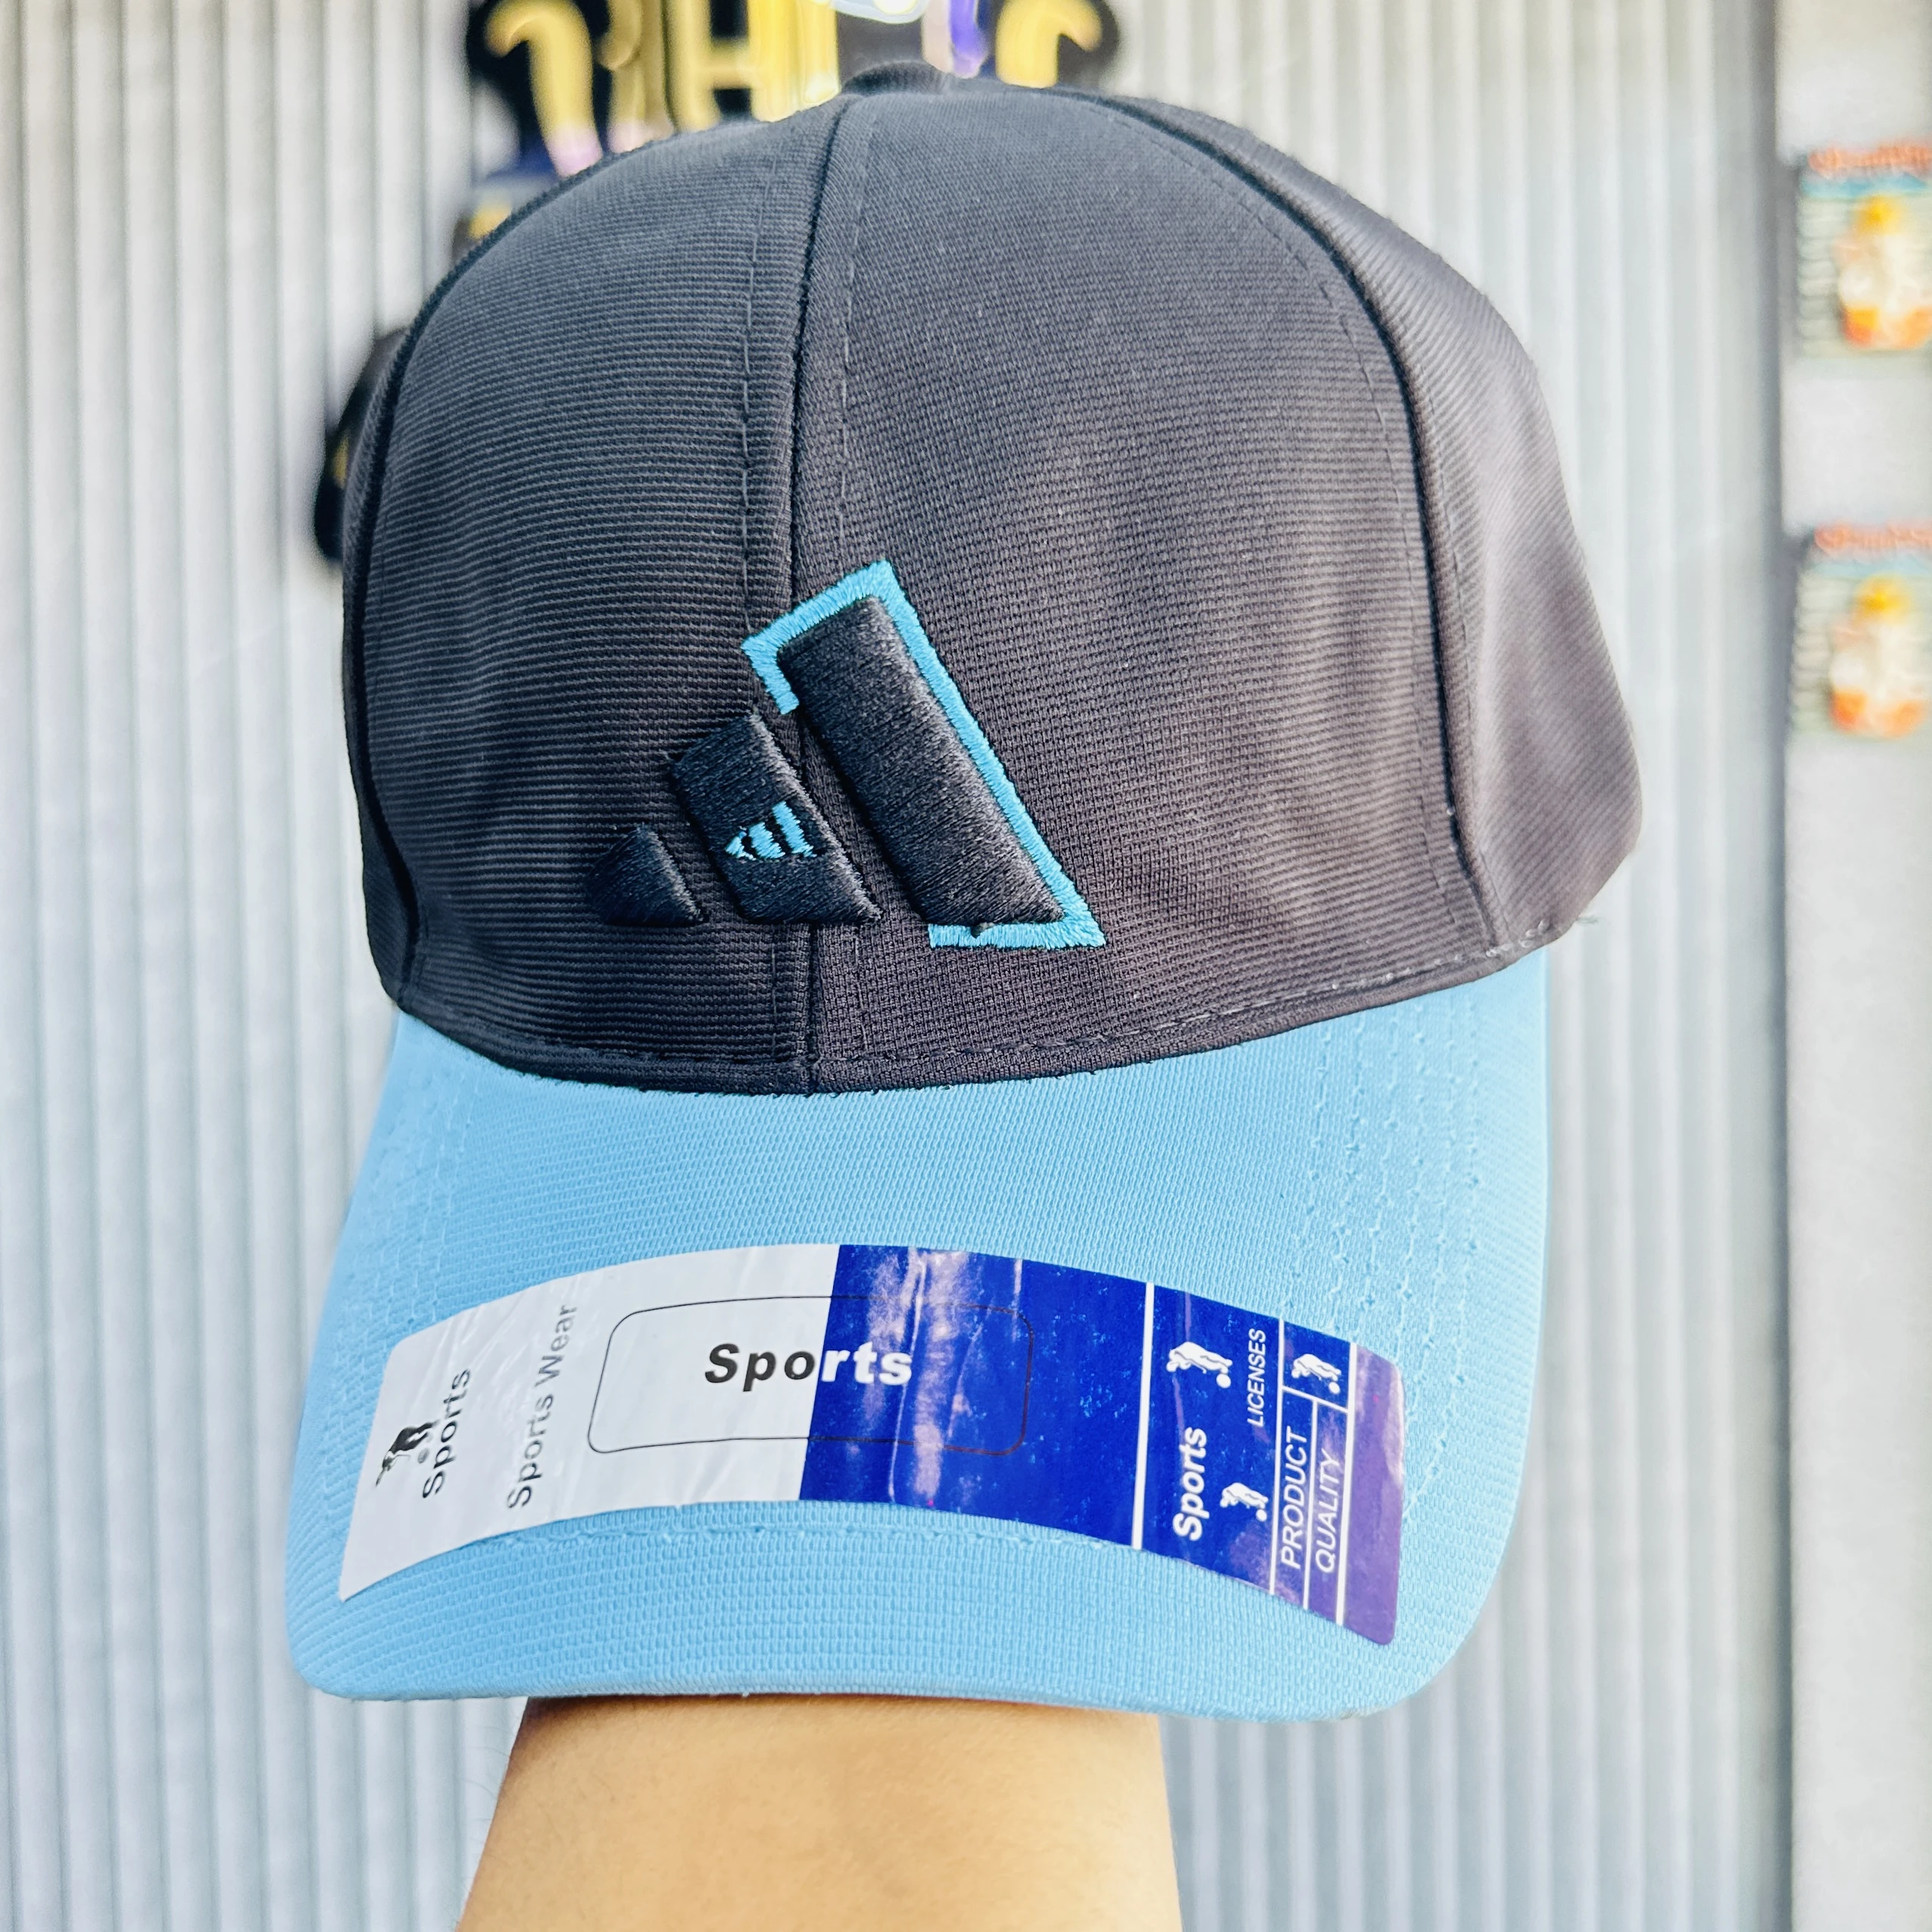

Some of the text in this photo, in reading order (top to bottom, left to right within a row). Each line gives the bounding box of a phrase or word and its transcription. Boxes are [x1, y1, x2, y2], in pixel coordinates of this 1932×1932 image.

[507, 1304, 578, 1510] Sports Wear
[704, 1341, 913, 1392] Sports
[1247, 1328, 1266, 1428] LICENSES
[422, 1369, 471, 1500] Sports
[1172, 1427, 1209, 1541] Sports
[1280, 1426, 1308, 1570] PRODUCT
[1314, 1448, 1343, 1574] QUALITY
